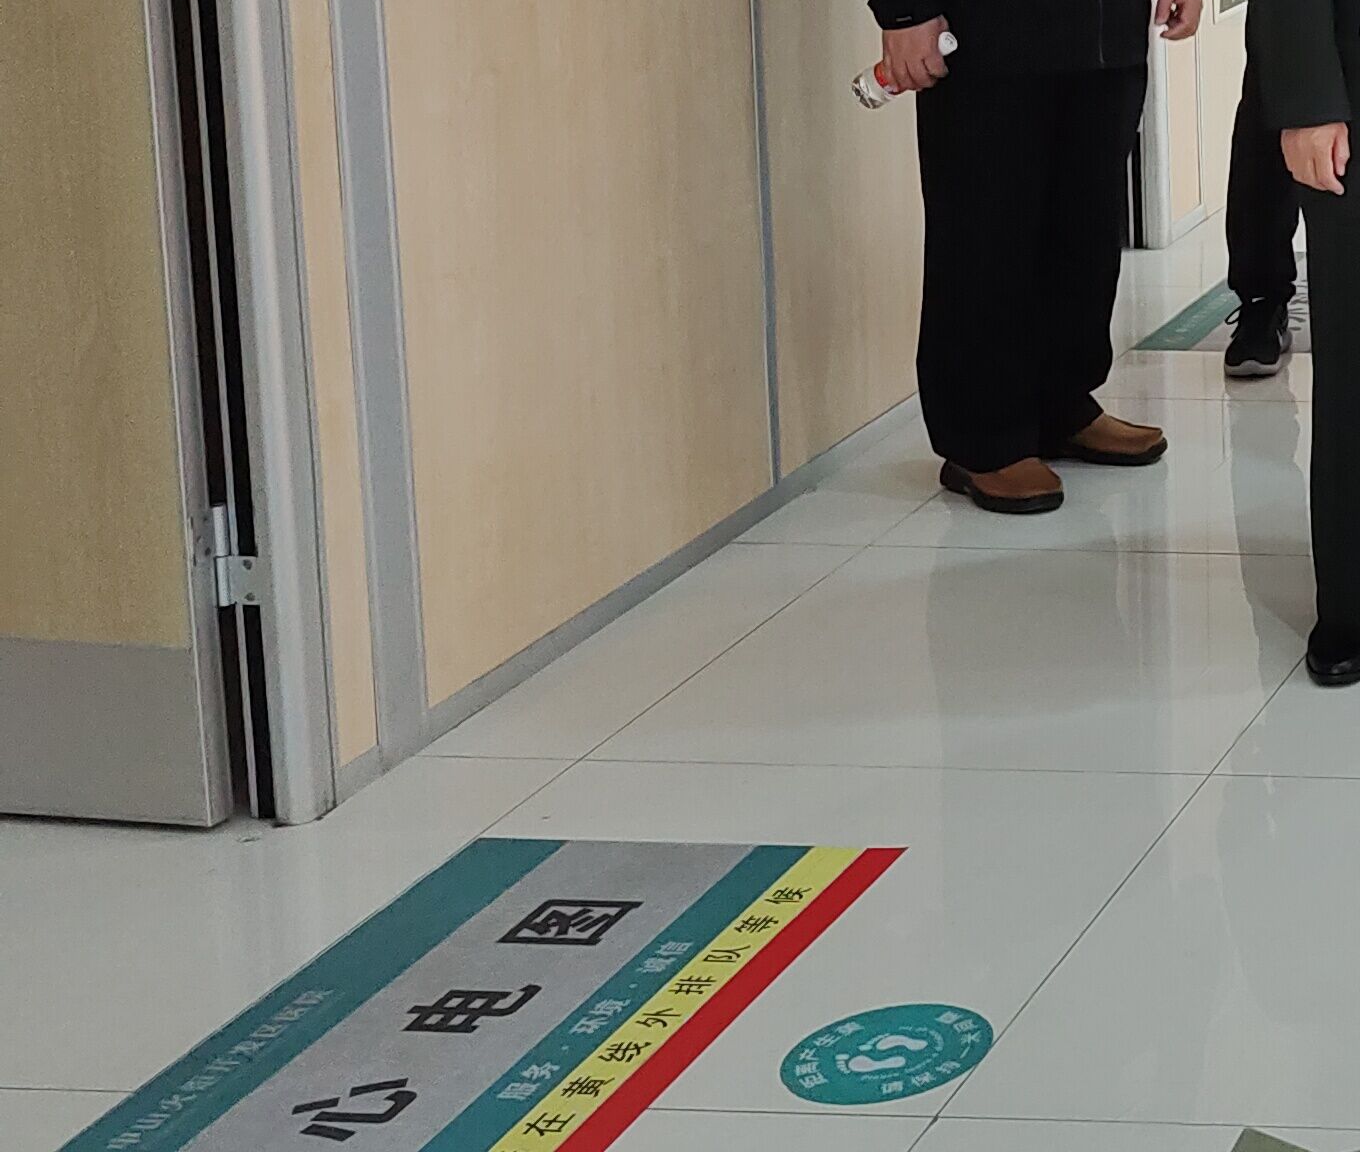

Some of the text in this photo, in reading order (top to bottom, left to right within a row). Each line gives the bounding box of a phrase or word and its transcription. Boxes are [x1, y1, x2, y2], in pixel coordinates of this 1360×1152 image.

[290, 898, 645, 1142] 心电图
[500, 885, 812, 1152] 在黄线外排队等候
